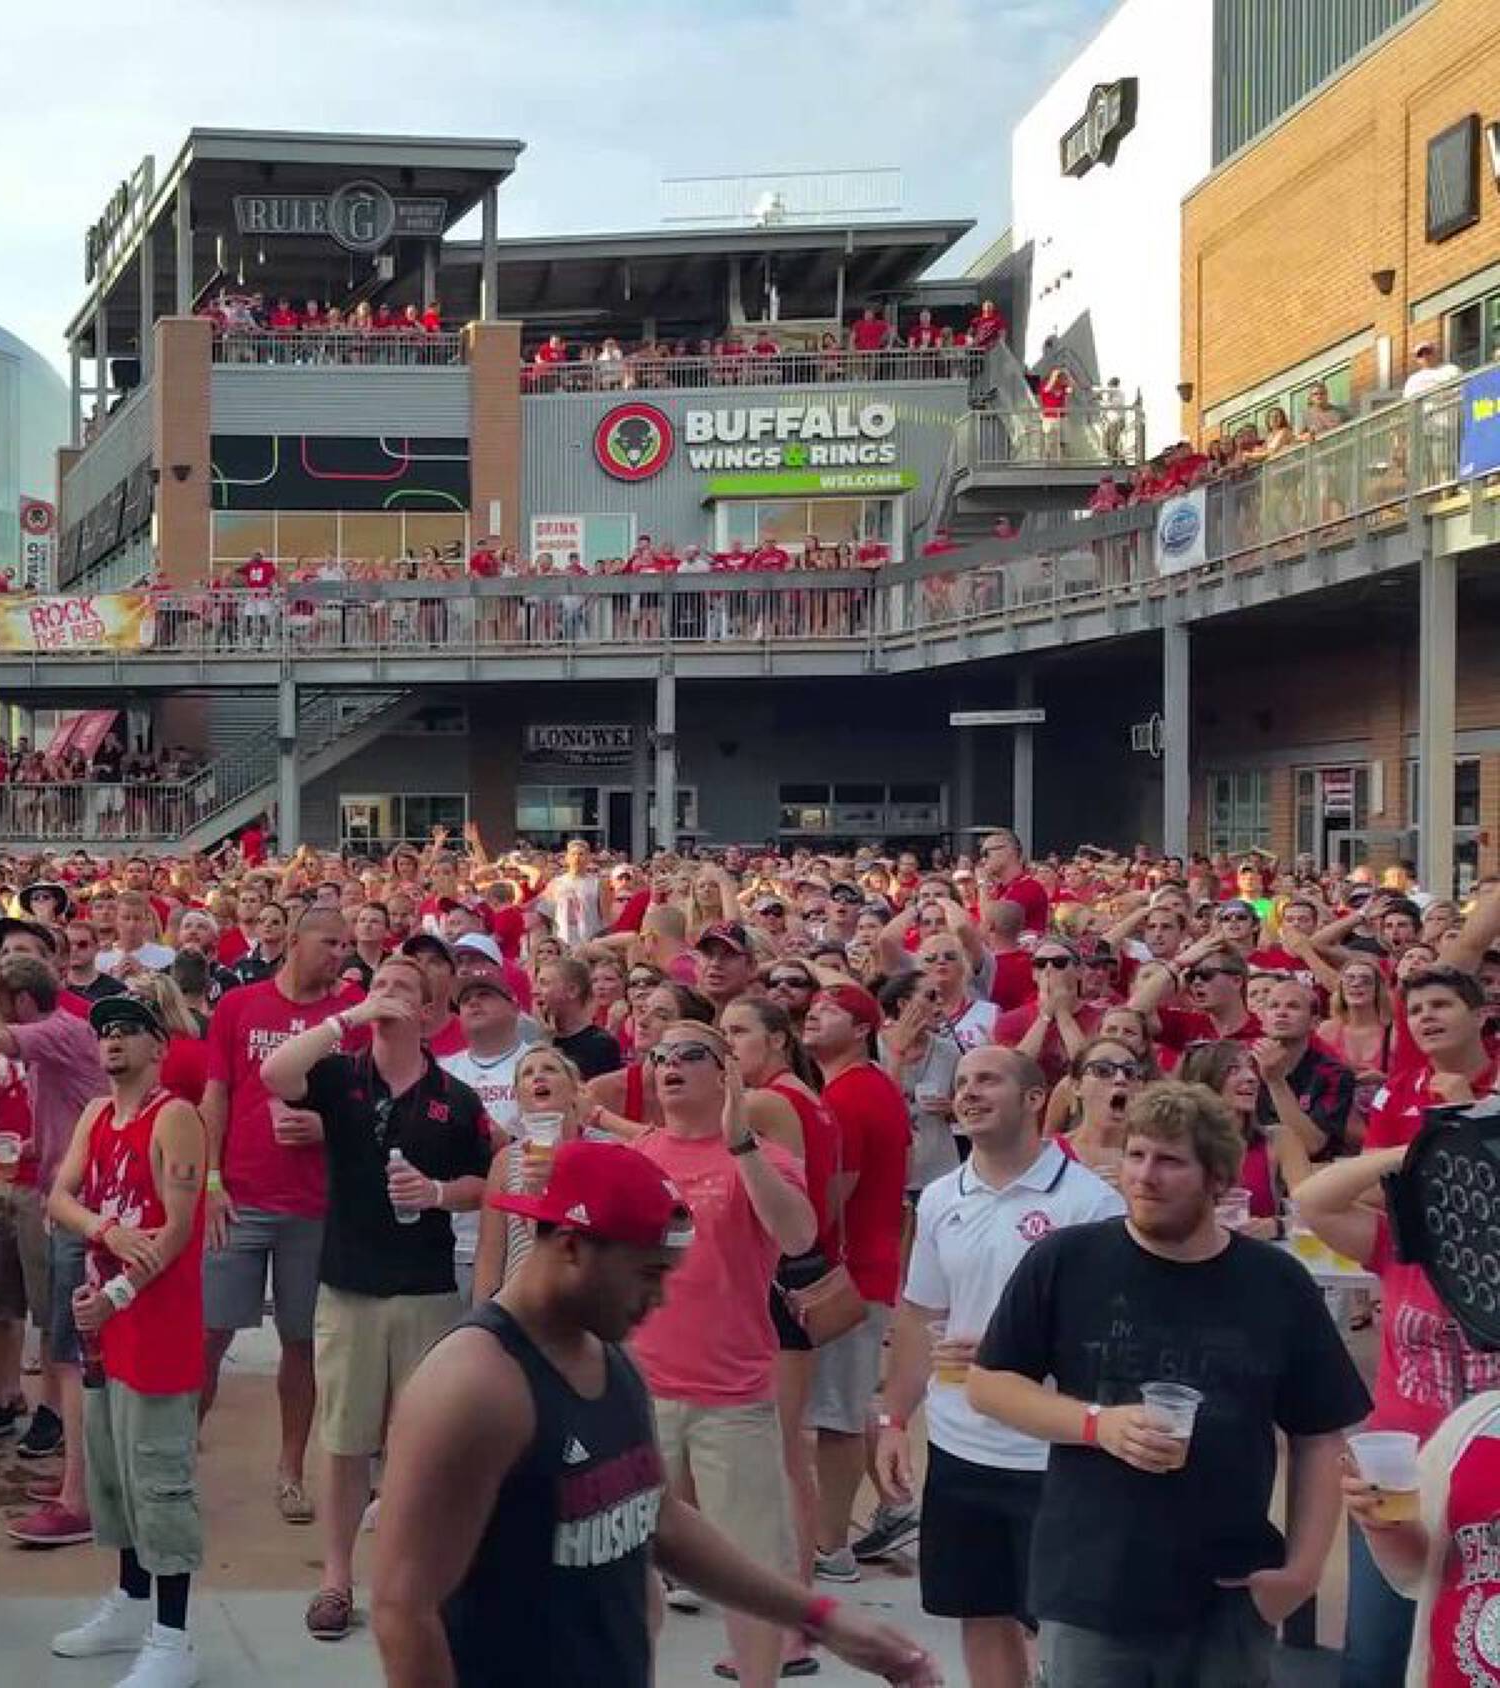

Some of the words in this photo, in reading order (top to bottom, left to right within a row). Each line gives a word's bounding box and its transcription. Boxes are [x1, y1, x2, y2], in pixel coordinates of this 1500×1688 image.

[252, 200, 326, 229] RULE
[351, 192, 375, 239] G
[686, 404, 896, 443] BUFFALO
[690, 448, 781, 468] WINGS
[782, 443, 811, 467] &
[810, 445, 896, 465] RINGS
[30, 598, 99, 626] ROCK
[72, 621, 106, 641] RED
